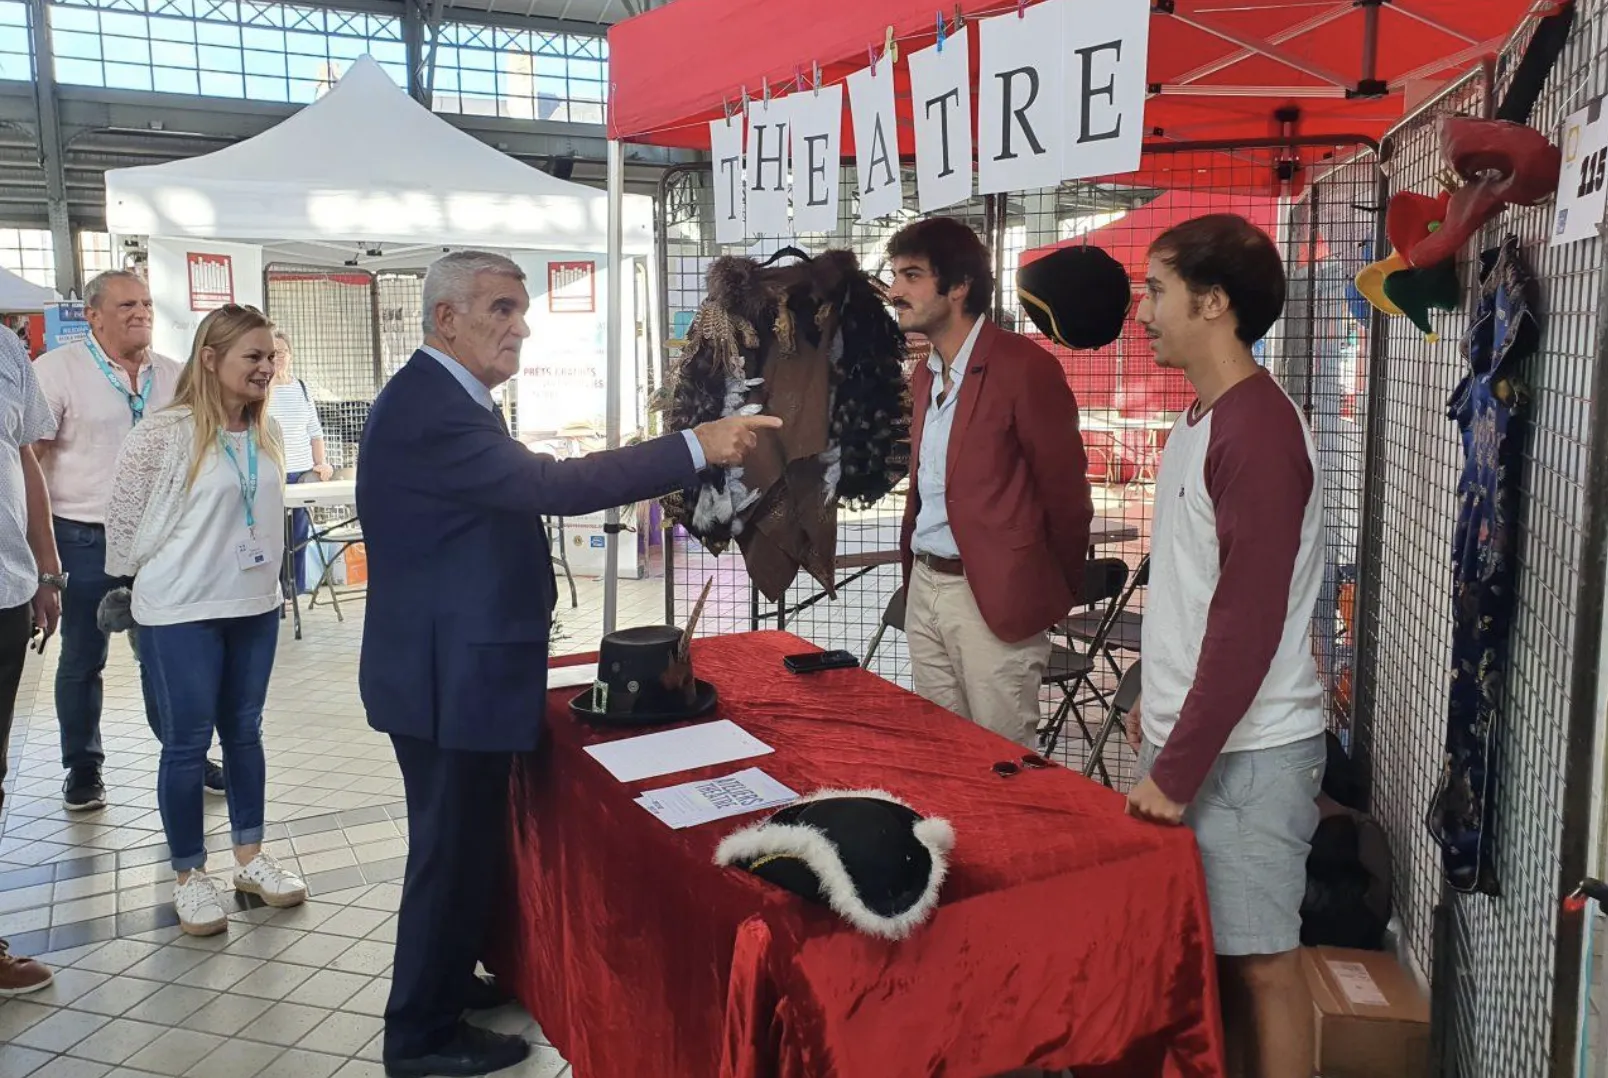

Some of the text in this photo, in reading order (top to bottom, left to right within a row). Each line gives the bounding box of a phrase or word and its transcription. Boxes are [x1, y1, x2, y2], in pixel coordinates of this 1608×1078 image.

[720, 38, 1122, 220] THEATRE
[1577, 146, 1608, 198] 115
[712, 777, 765, 807] ATELIERS
